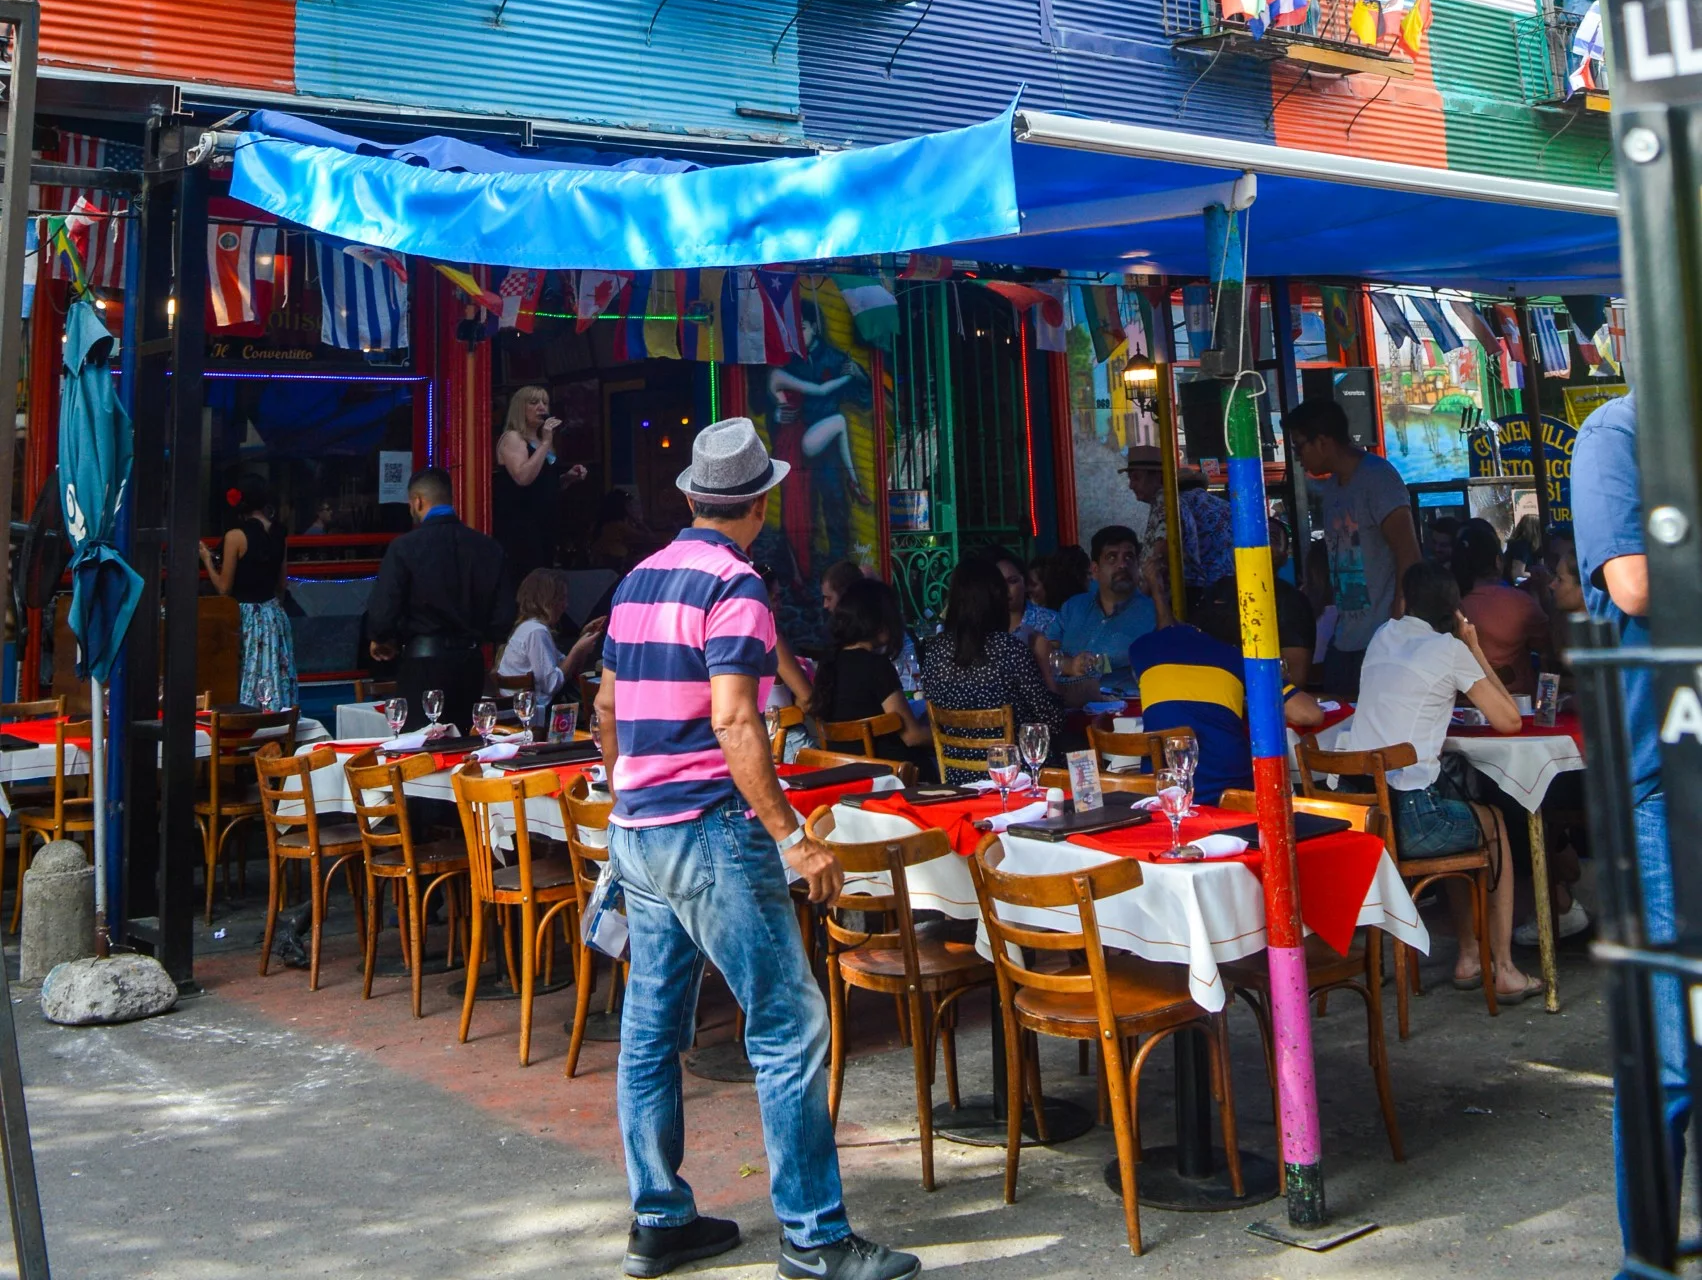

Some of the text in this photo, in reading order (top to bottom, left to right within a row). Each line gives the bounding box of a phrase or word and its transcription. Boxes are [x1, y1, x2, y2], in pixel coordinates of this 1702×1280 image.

[242, 344, 314, 360] Conventillo
[1473, 420, 1576, 457] COVENILLO
[1480, 458, 1572, 479] HISTOICO
